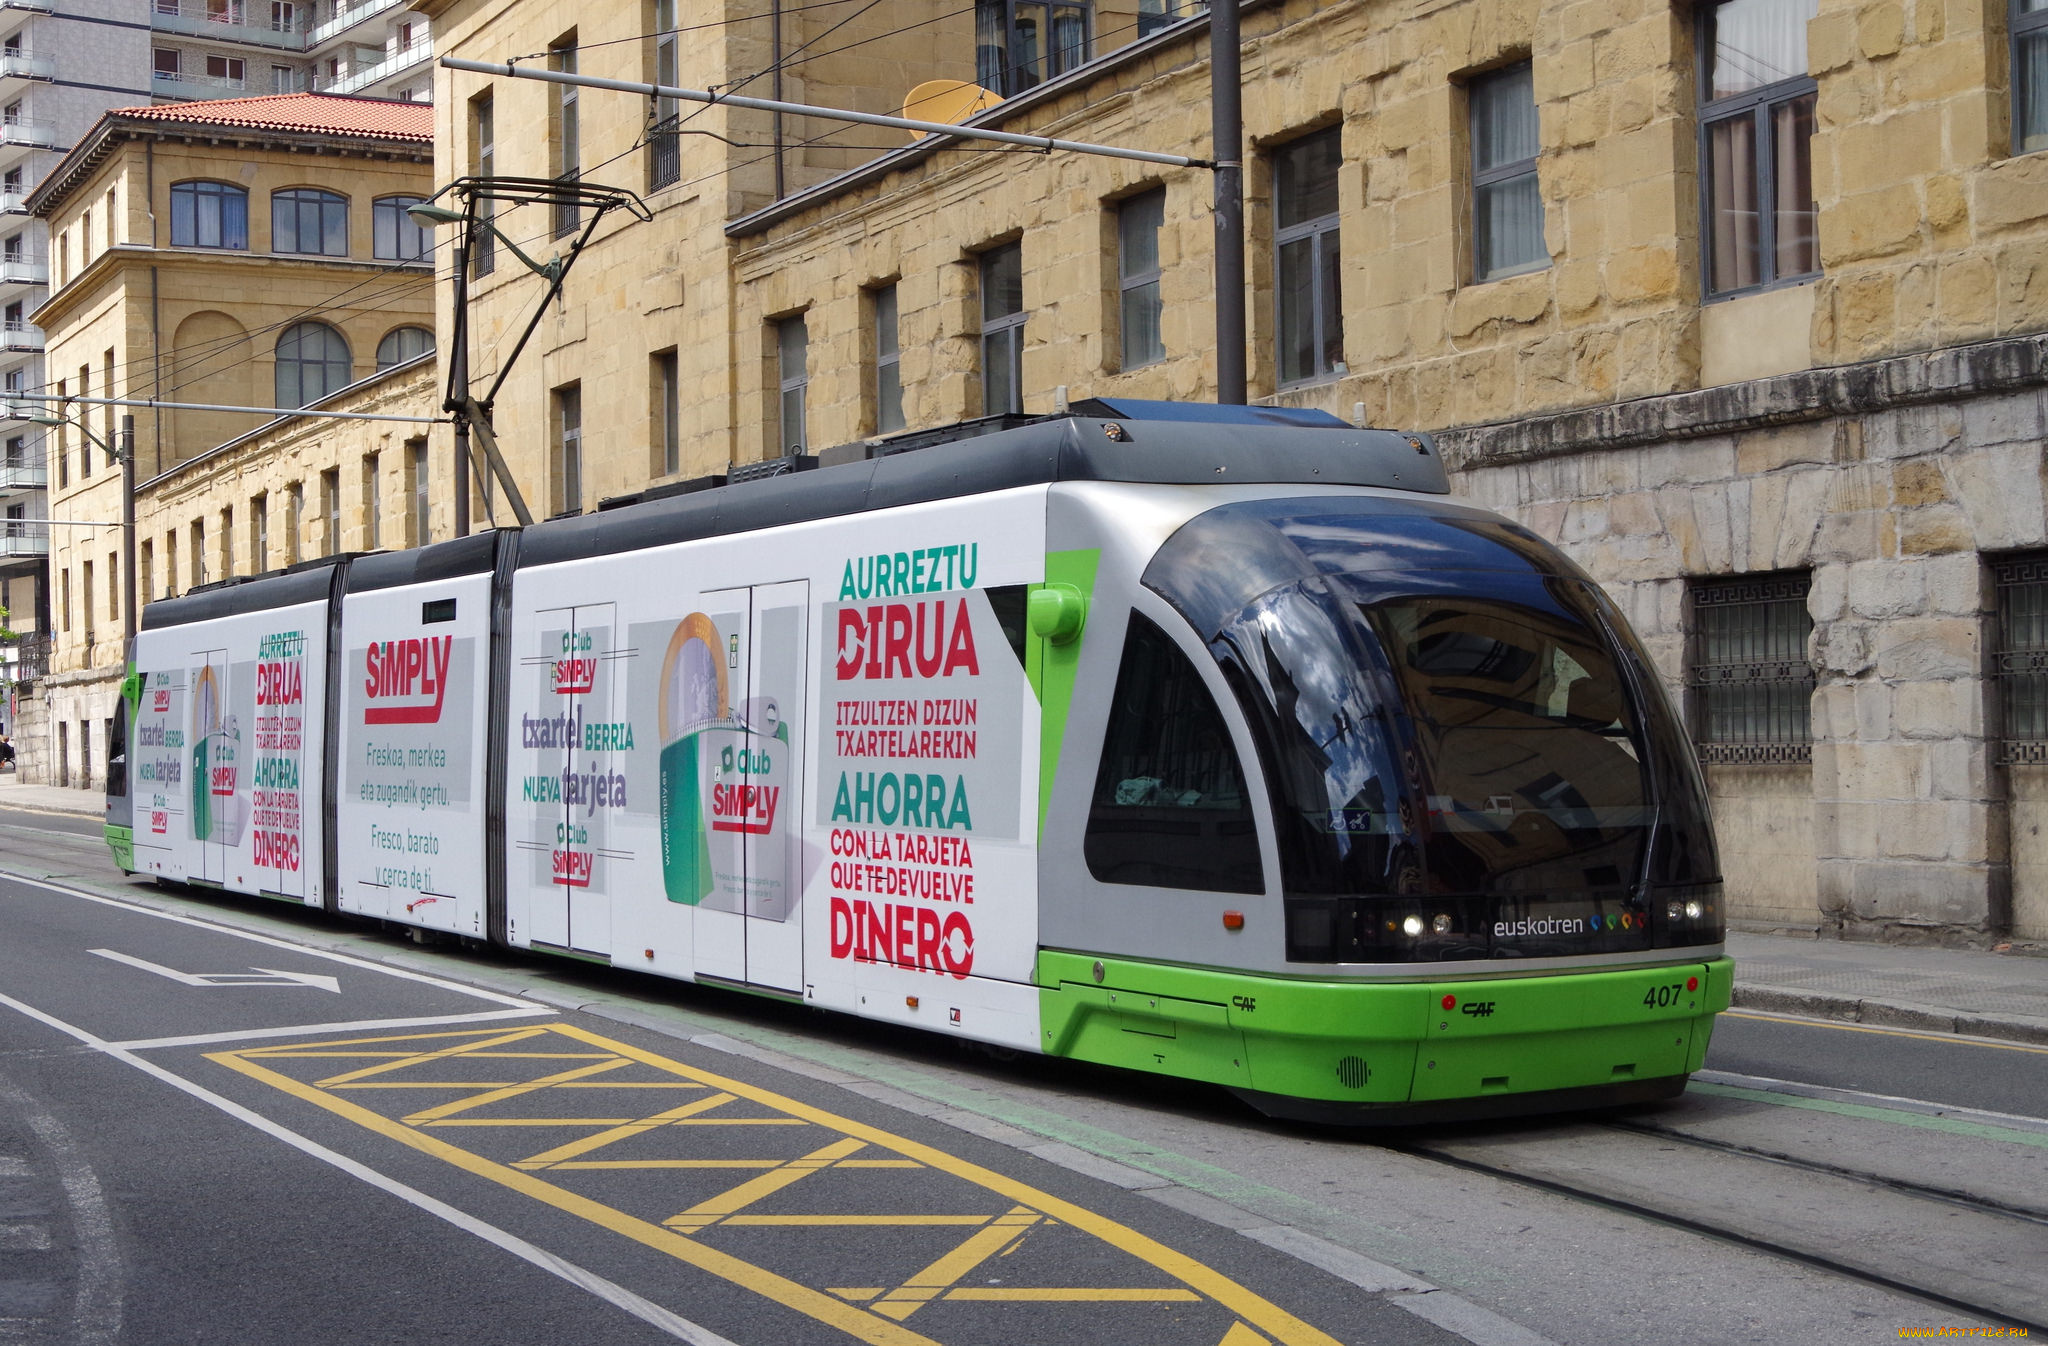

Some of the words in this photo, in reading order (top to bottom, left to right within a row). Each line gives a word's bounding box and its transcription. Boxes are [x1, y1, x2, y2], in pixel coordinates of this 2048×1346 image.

[838, 542, 978, 601] AURREZTU
[258, 630, 304, 660] AURREZTU
[571, 632, 592, 651] Club
[836, 598, 980, 680] DIRUA
[160, 674, 169, 685] Club
[257, 662, 302, 705] DIRUA
[284, 716, 302, 732] DIZUN
[836, 700, 918, 726] ITZULTZEN
[924, 699, 976, 726] DIZUN
[140, 718, 164, 747] txartel
[165, 730, 184, 748] BERRIA
[256, 734, 302, 750] TXARTELAREKIN
[522, 704, 582, 749] txartel
[586, 722, 634, 751] BERRIA
[222, 746, 235, 760] Club
[366, 742, 406, 770] Freskoa,
[408, 742, 446, 768] merkea
[836, 730, 976, 759] TXARTELAREKIN
[140, 764, 156, 780] NUEVA
[156, 754, 181, 789] tarjeta
[254, 758, 298, 789] AHORRA
[738, 750, 770, 775] Club
[254, 792, 266, 806] CON
[268, 792, 274, 807] LA
[274, 792, 299, 810] TARJETA
[360, 780, 374, 801] eta
[376, 779, 417, 808] zugandik
[420, 782, 450, 811] gertu.
[524, 776, 560, 802] NUEVA
[562, 761, 626, 818] tarjeta
[832, 770, 972, 830] AHORRA
[254, 810, 264, 826] QUE
[265, 811, 271, 826] TE
[272, 811, 299, 830] DEVUELVE
[568, 825, 588, 844] Club
[254, 830, 300, 872] DINERO
[372, 824, 405, 854] Fresco,
[408, 828, 438, 855] barato
[830, 828, 866, 858] CON
[872, 832, 892, 860] LA
[896, 834, 973, 868] TARJETA
[376, 866, 380, 889] y
[382, 868, 408, 888] cerca
[410, 866, 422, 890] de
[424, 868, 434, 892] ti.
[830, 861, 862, 891] QUE
[866, 864, 883, 894] TE
[886, 866, 974, 904] DEVUELVE
[830, 896, 974, 980] DINERO
[1494, 915, 1583, 937] euskotren
[1232, 996, 1256, 1012] CAF
[1462, 1002, 1495, 1018] CAF
[1643, 984, 1682, 1009] 407
